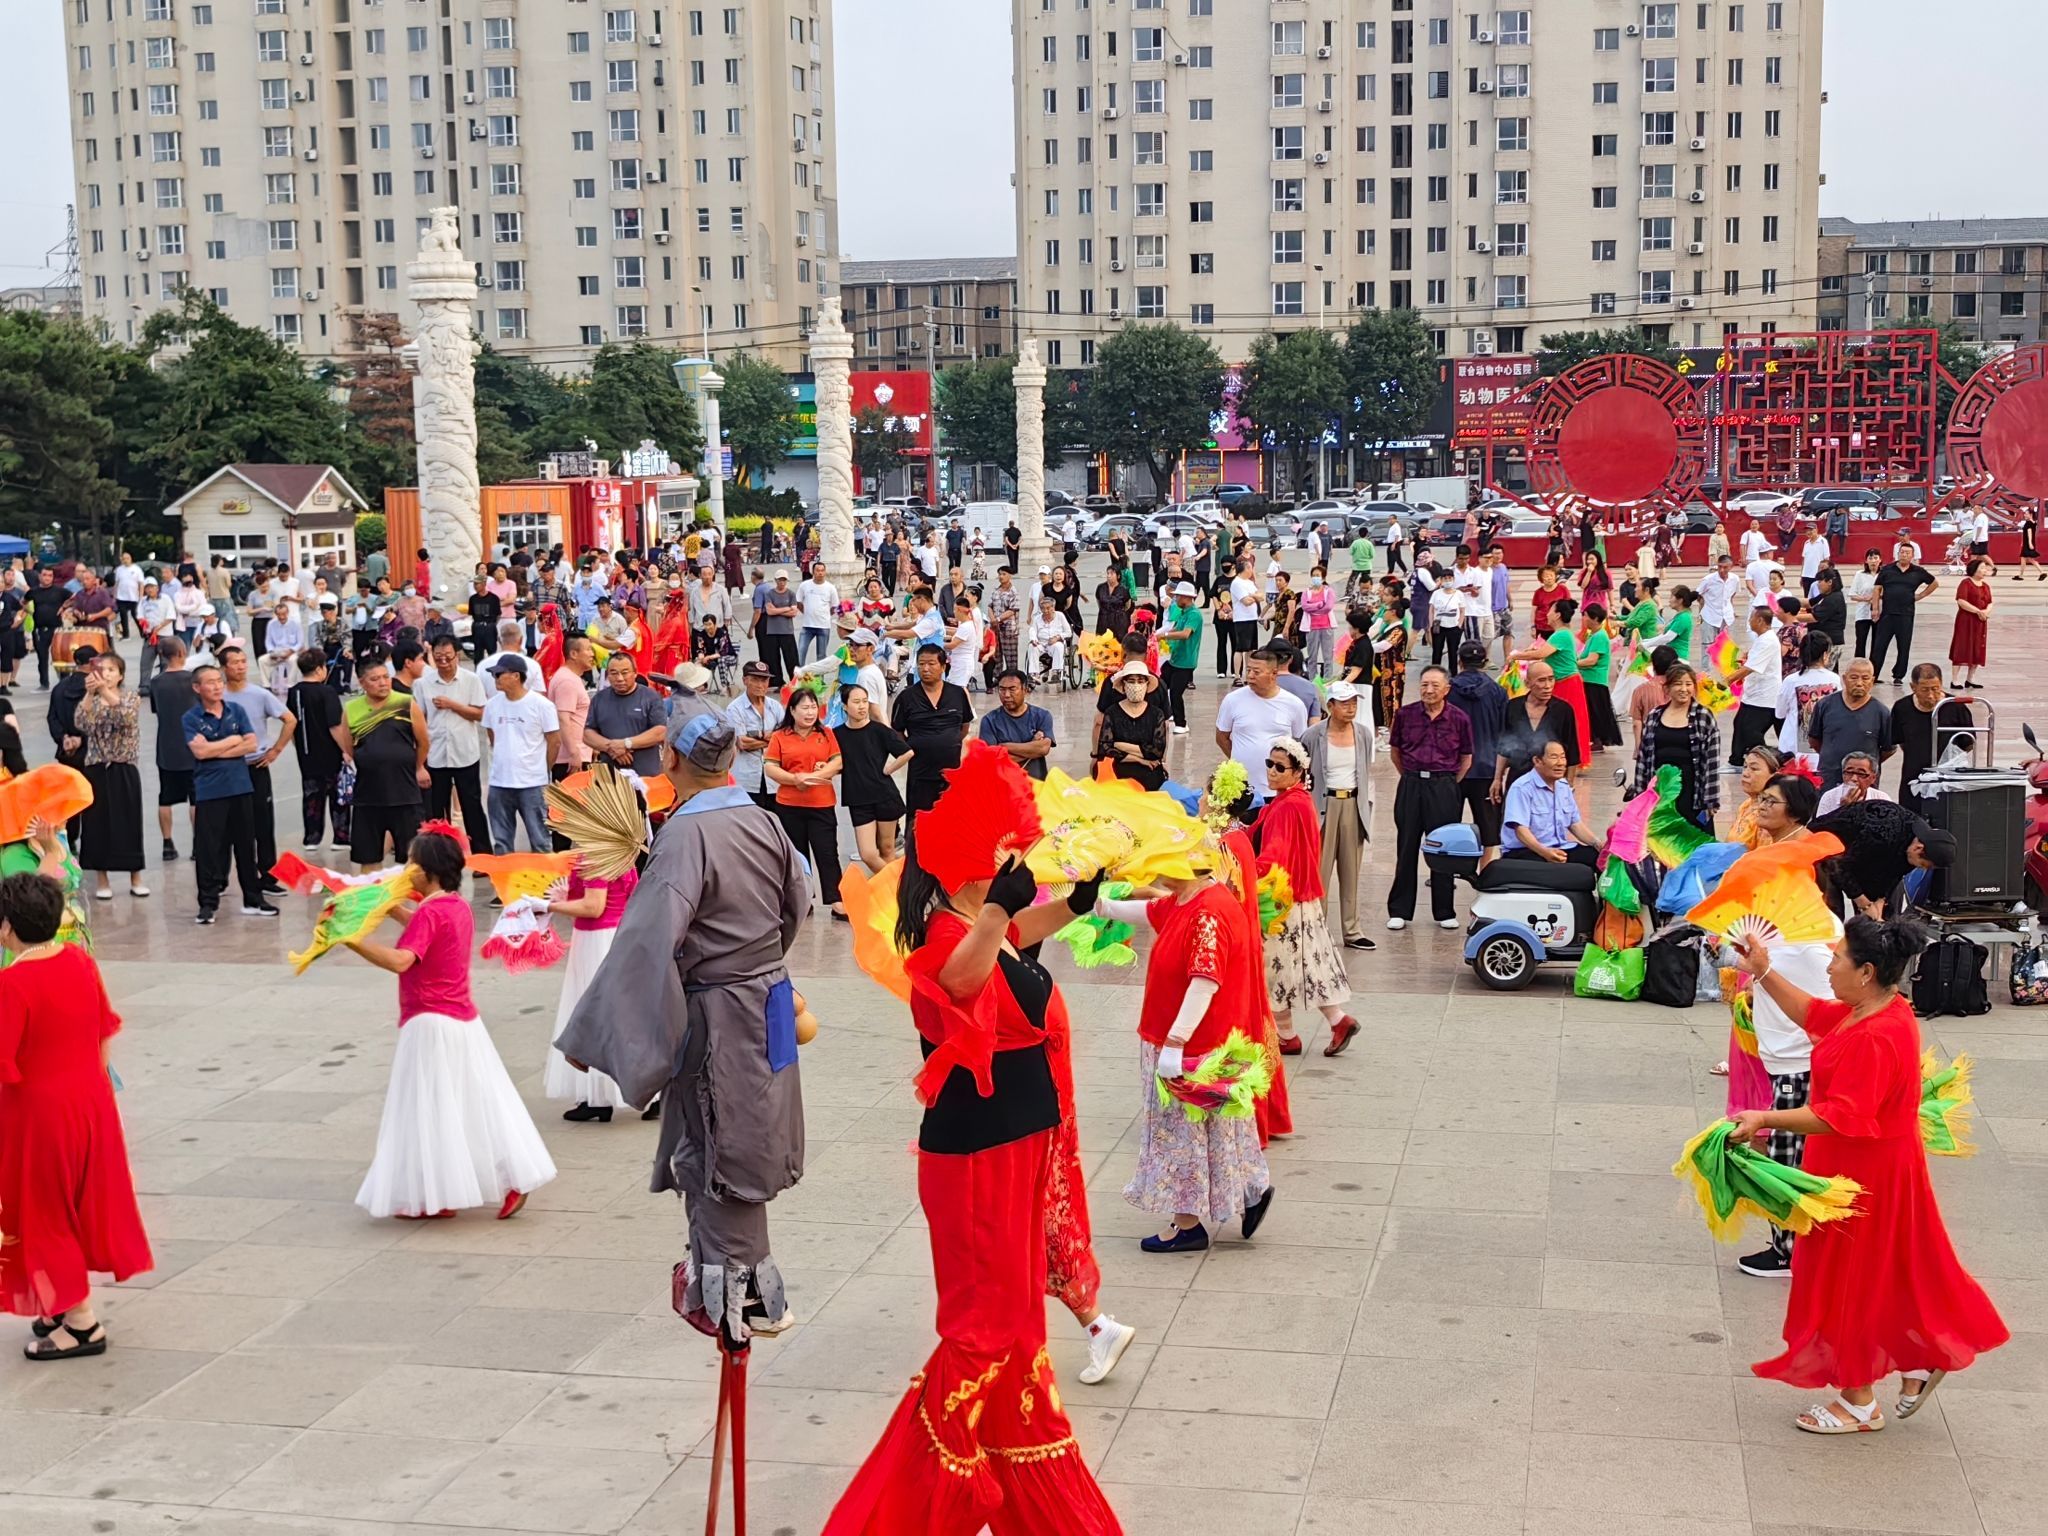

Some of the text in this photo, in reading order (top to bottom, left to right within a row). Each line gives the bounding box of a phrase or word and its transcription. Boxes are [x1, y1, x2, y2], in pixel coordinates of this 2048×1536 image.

[1458, 363, 1532, 377] 联合动物中心医院
